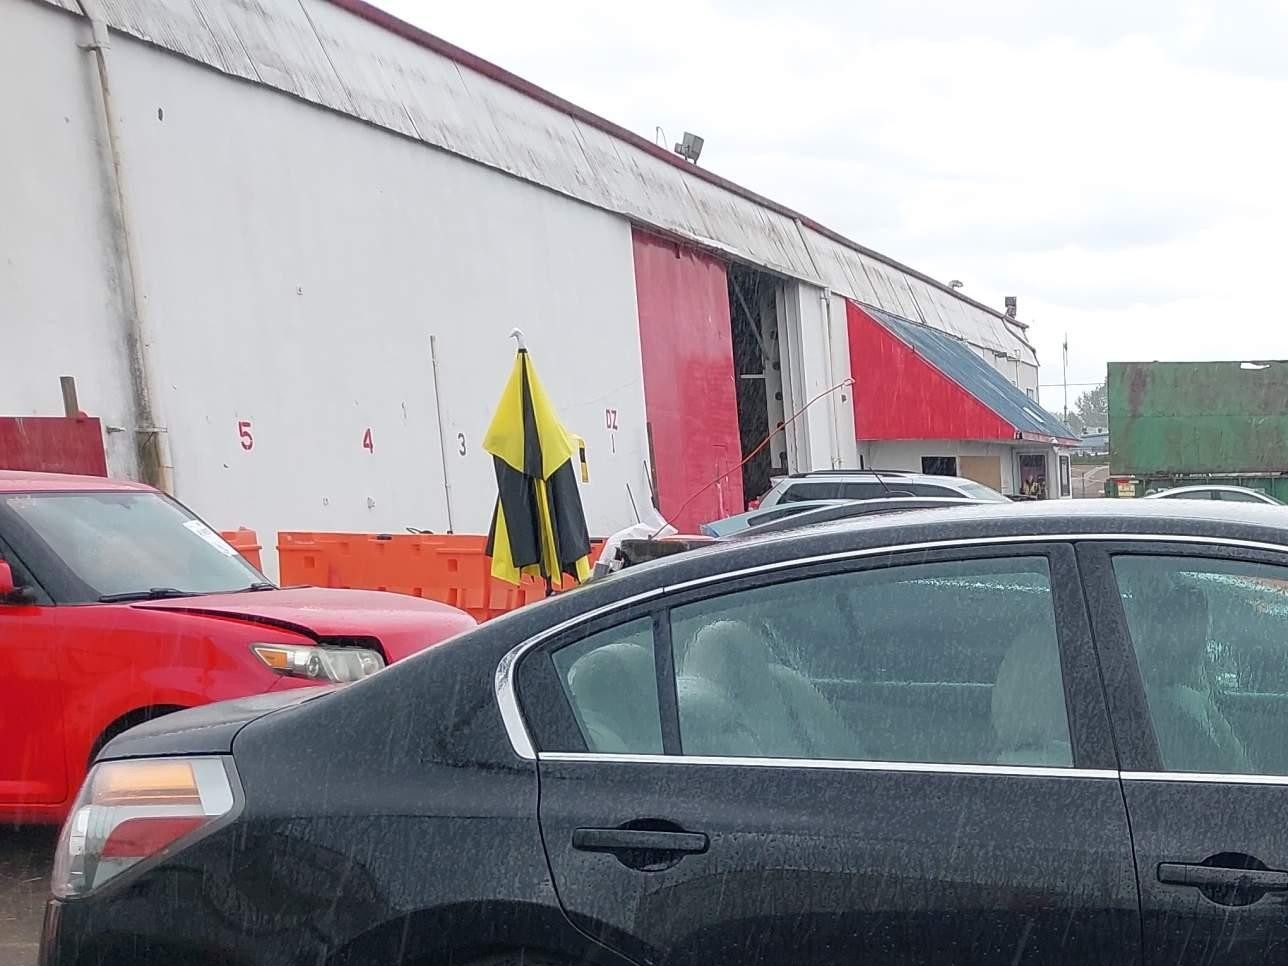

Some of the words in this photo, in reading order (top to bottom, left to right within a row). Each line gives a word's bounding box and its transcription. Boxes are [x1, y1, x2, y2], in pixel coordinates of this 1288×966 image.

[238, 421, 253, 450] 5
[363, 428, 374, 454] 4
[457, 432, 466, 456] 3
